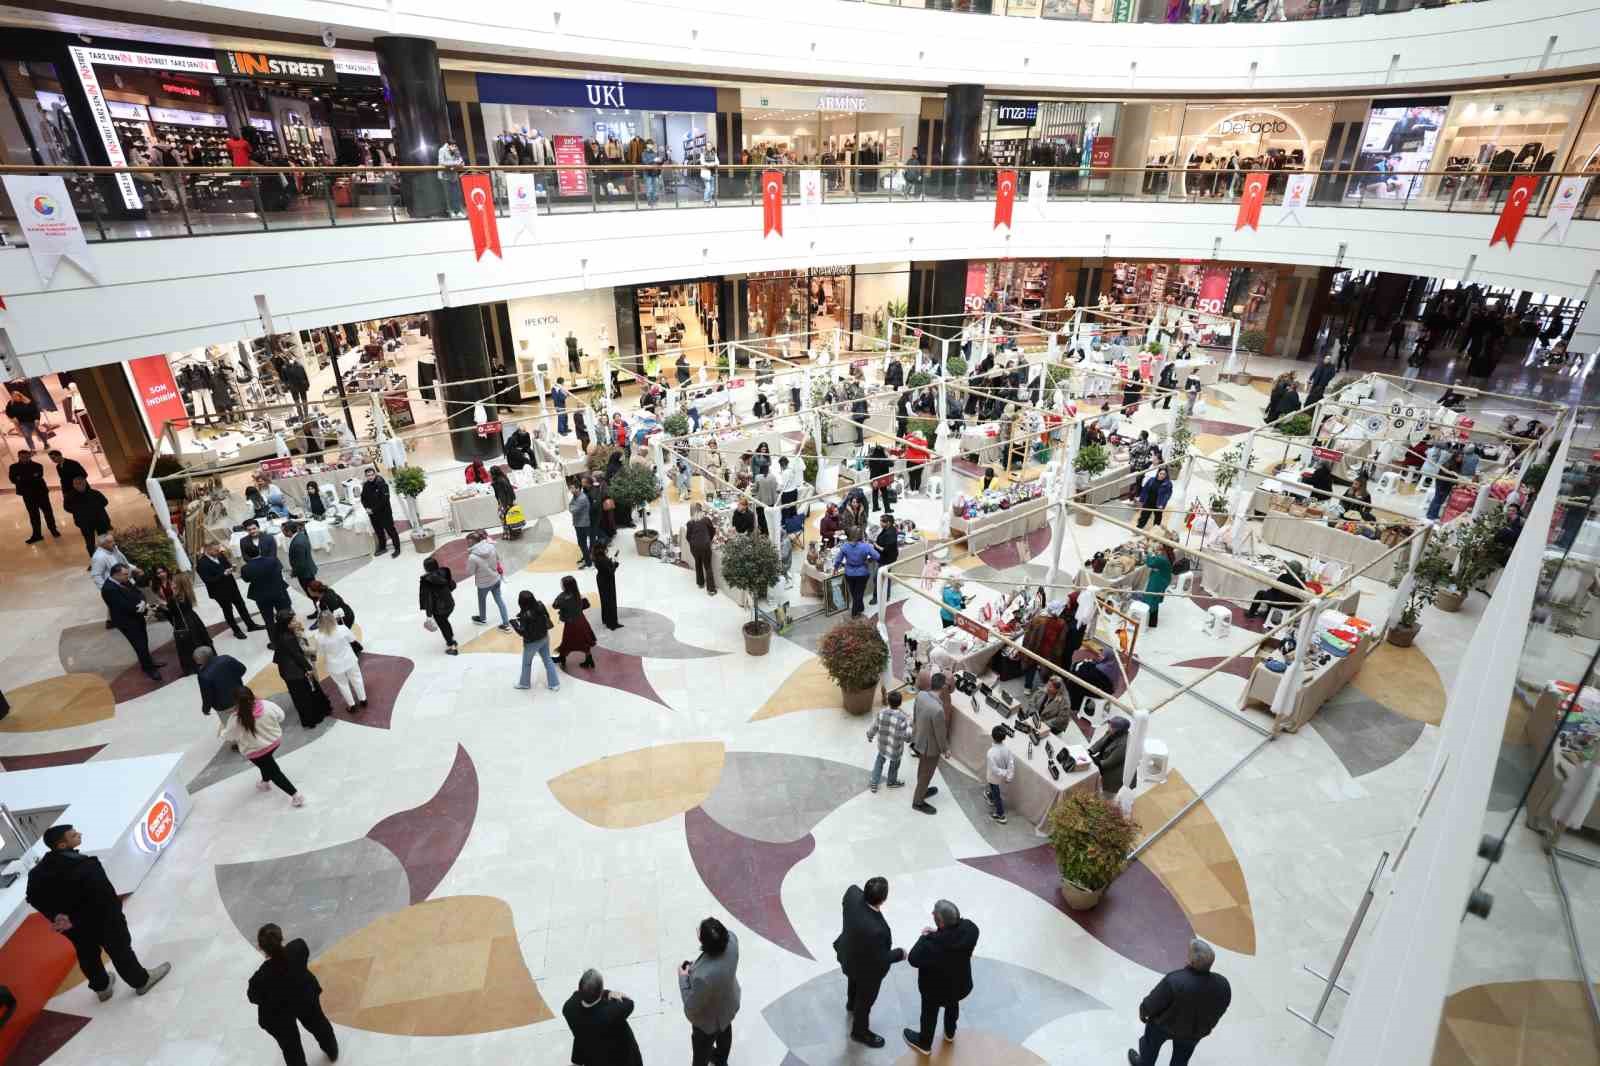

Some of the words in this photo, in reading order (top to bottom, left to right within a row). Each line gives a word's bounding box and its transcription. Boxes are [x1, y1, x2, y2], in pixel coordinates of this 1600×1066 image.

[585, 82, 626, 108] UKİ
[1217, 119, 1288, 135] DeFacto
[149, 384, 167, 394] SON
